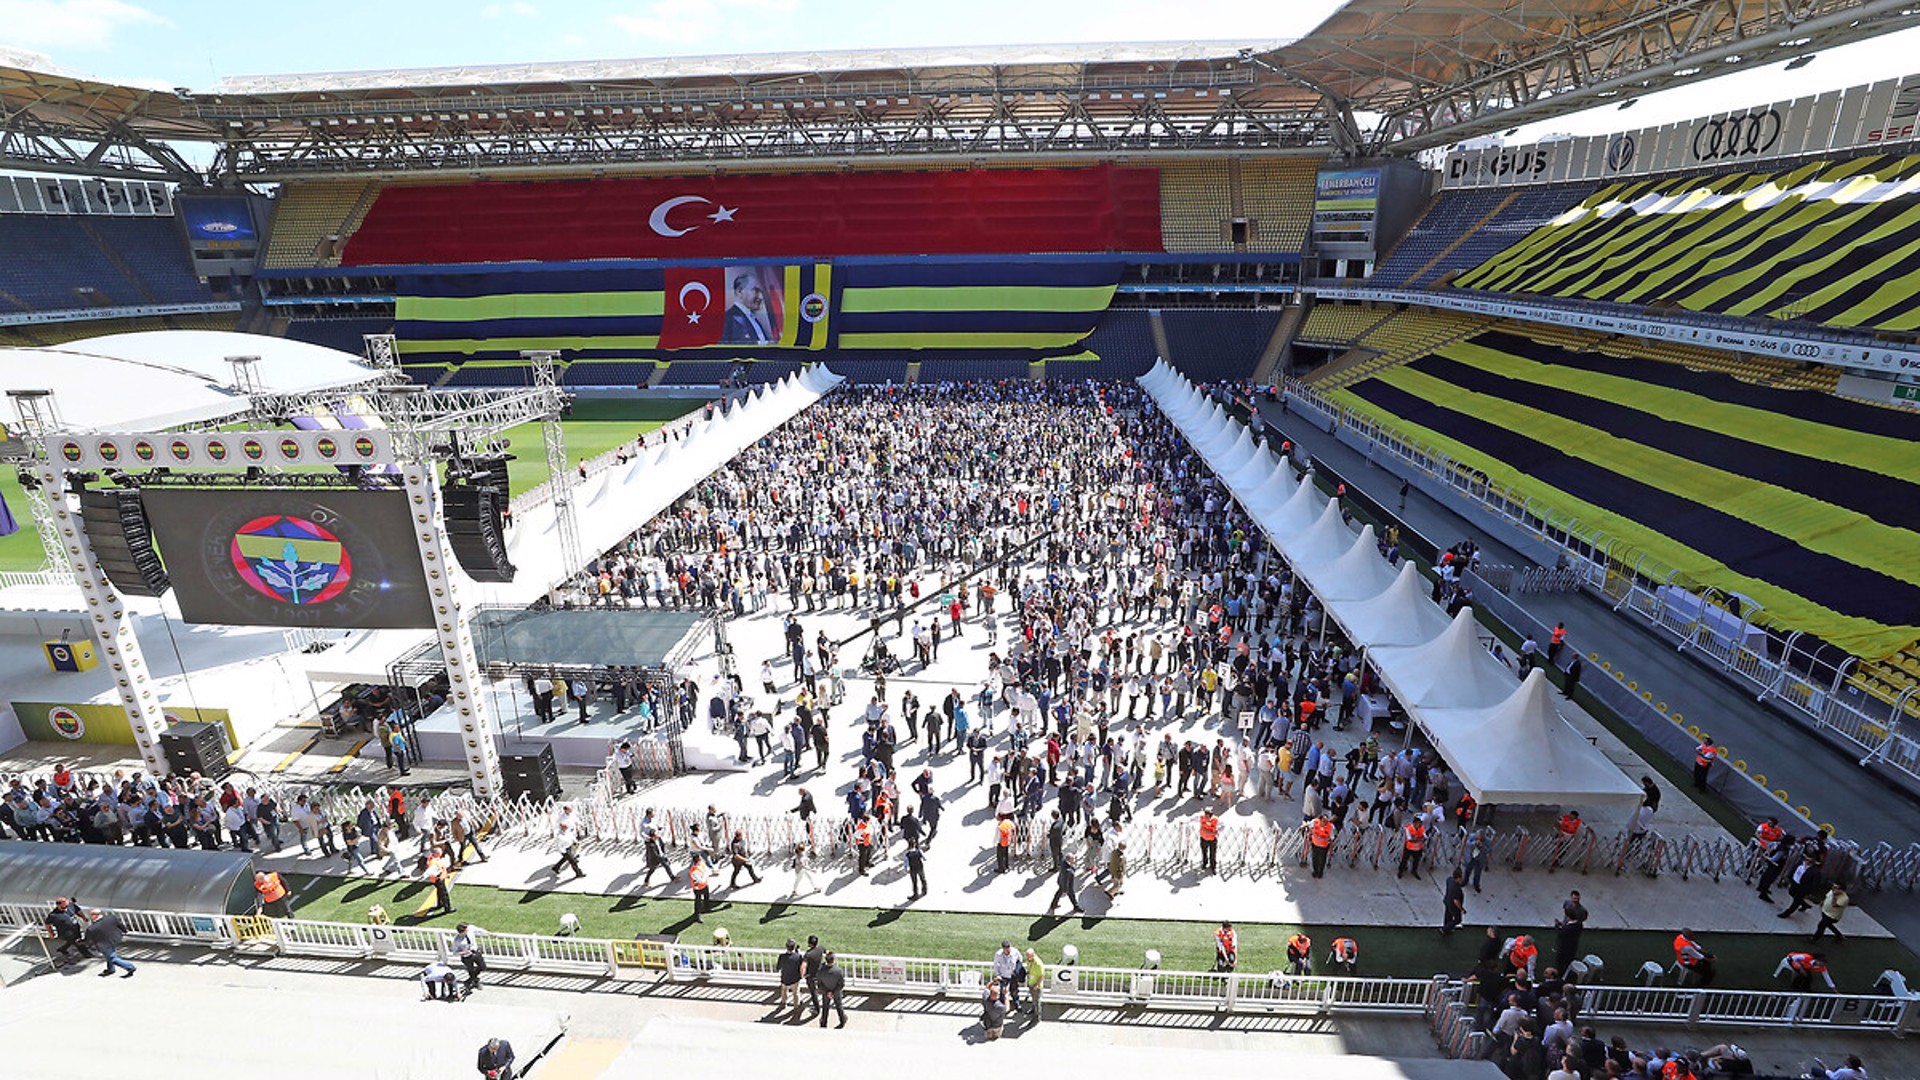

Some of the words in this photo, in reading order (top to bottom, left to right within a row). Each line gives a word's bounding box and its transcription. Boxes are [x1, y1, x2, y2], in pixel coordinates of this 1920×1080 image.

[1868, 125, 1914, 142] SEA
[1906, 388, 1917, 399] M
[373, 928, 386, 940] D
[1057, 969, 1072, 982] C
[1843, 999, 1859, 1012] B
